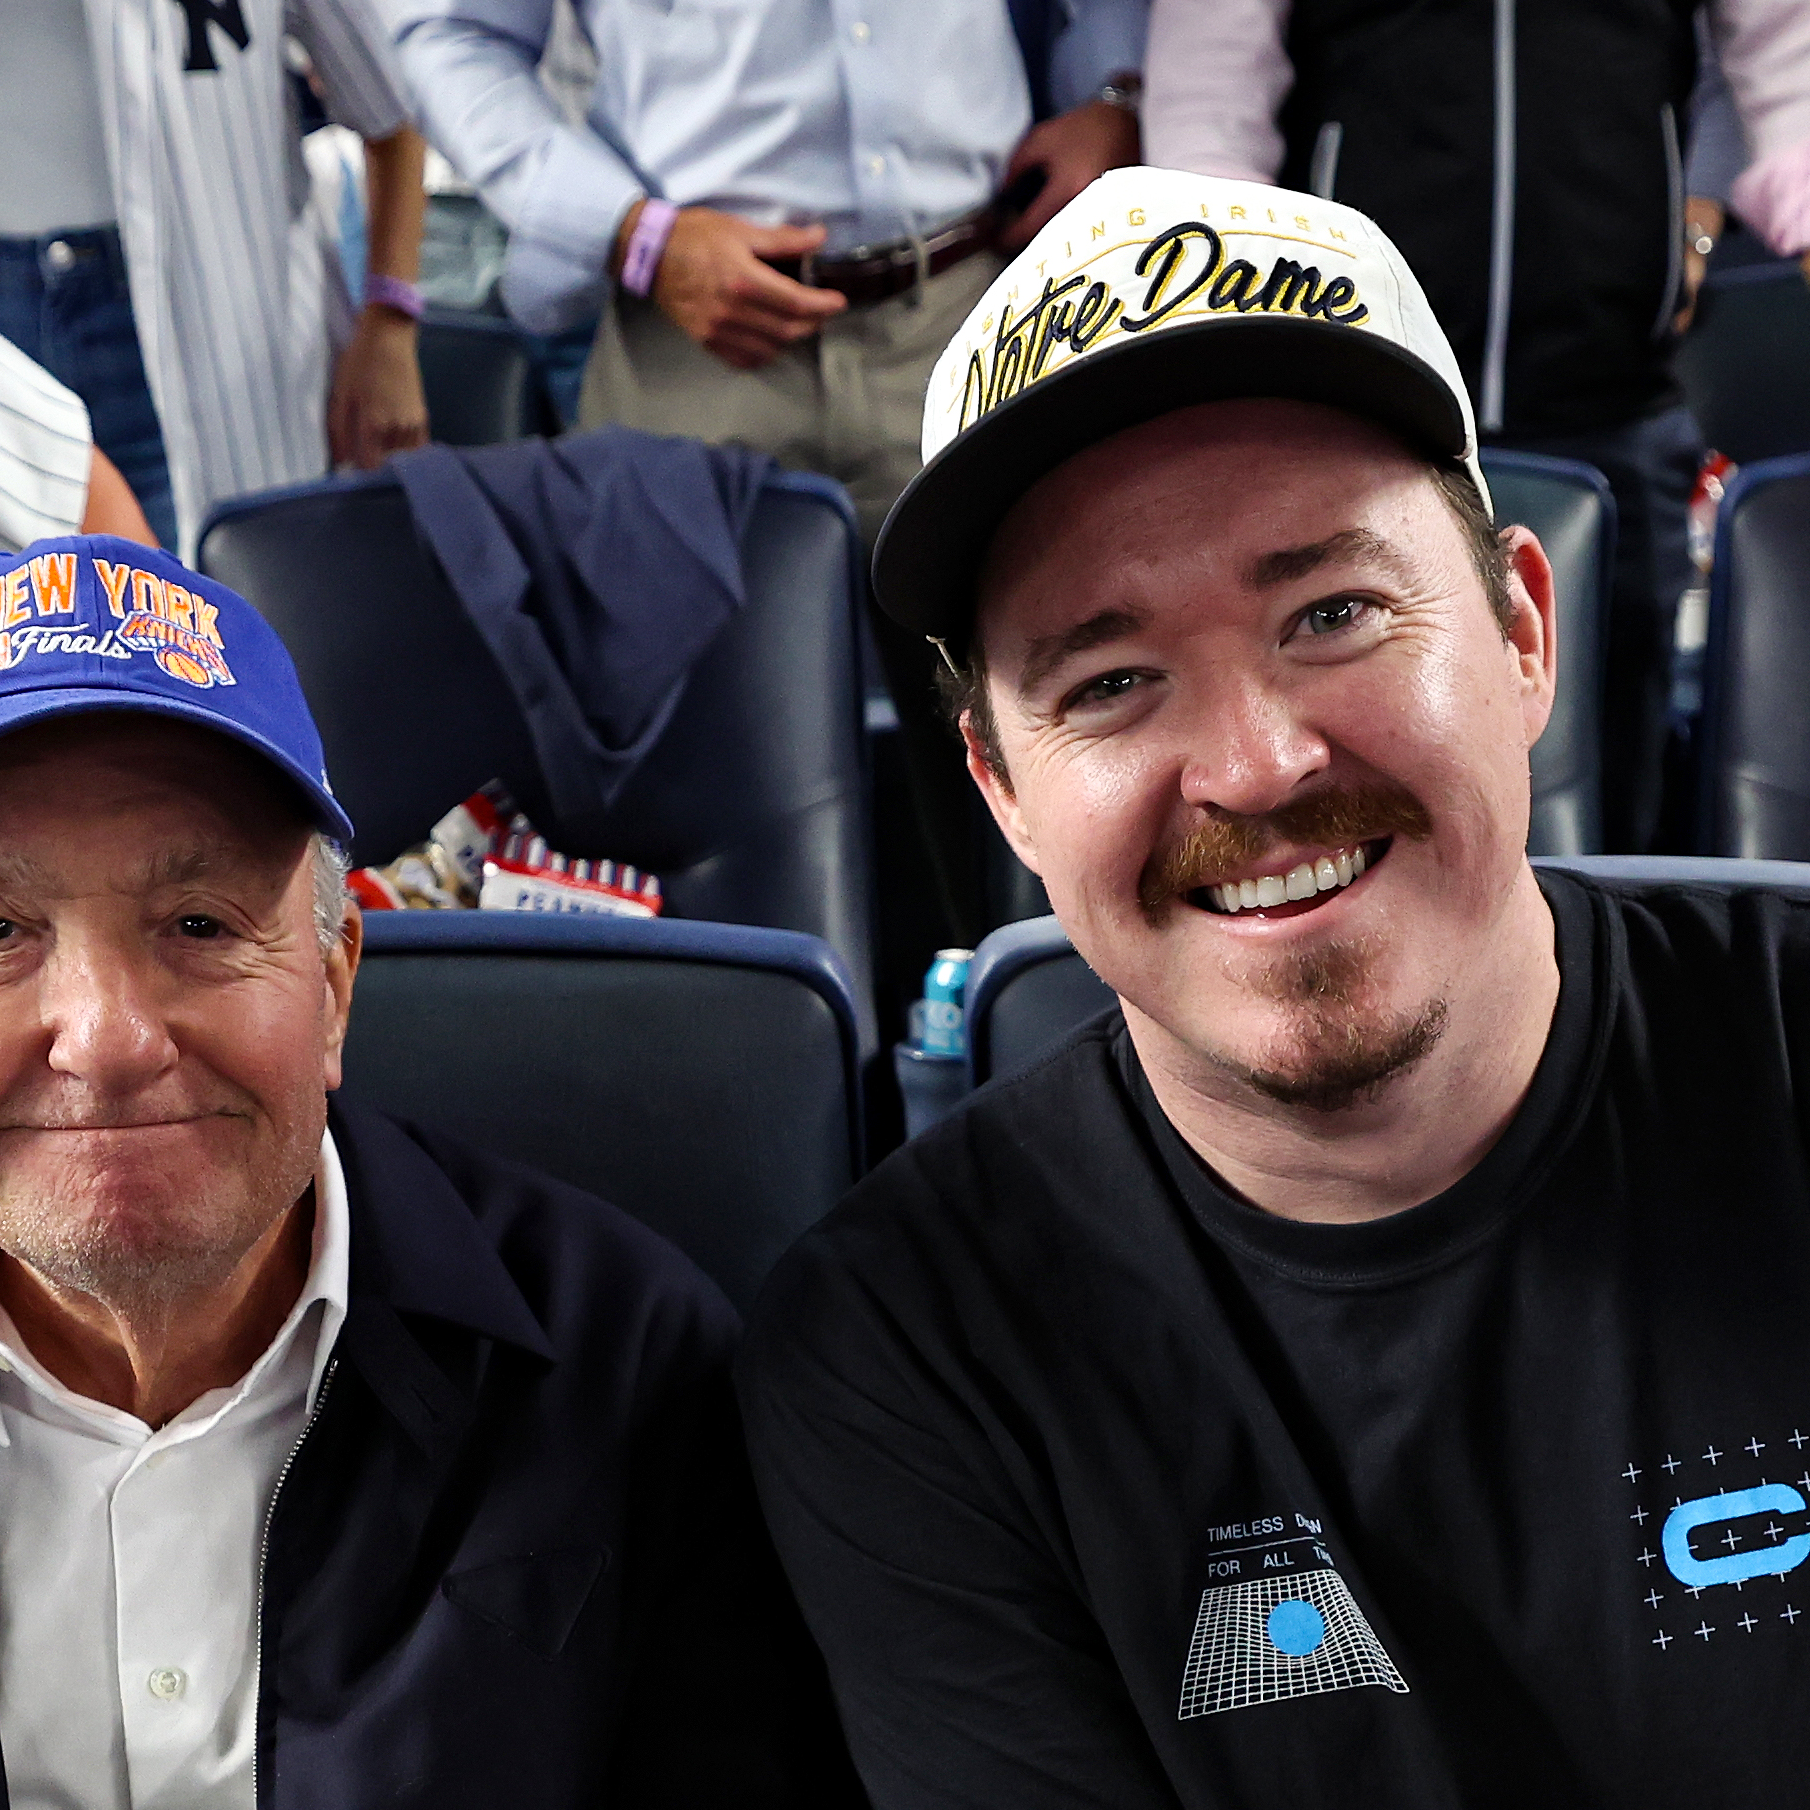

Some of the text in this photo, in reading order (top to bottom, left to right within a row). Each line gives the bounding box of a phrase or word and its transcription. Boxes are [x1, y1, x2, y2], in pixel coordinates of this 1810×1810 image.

[1199, 203, 1348, 242] IRISH
[957, 221, 1371, 434] Notre Dame
[92, 558, 226, 650] YORK
[7, 622, 133, 669] Finals
[1207, 1515, 1286, 1544] TIMELESS
[1207, 1558, 1243, 1580] FOR
[1262, 1550, 1296, 1570] ALL
